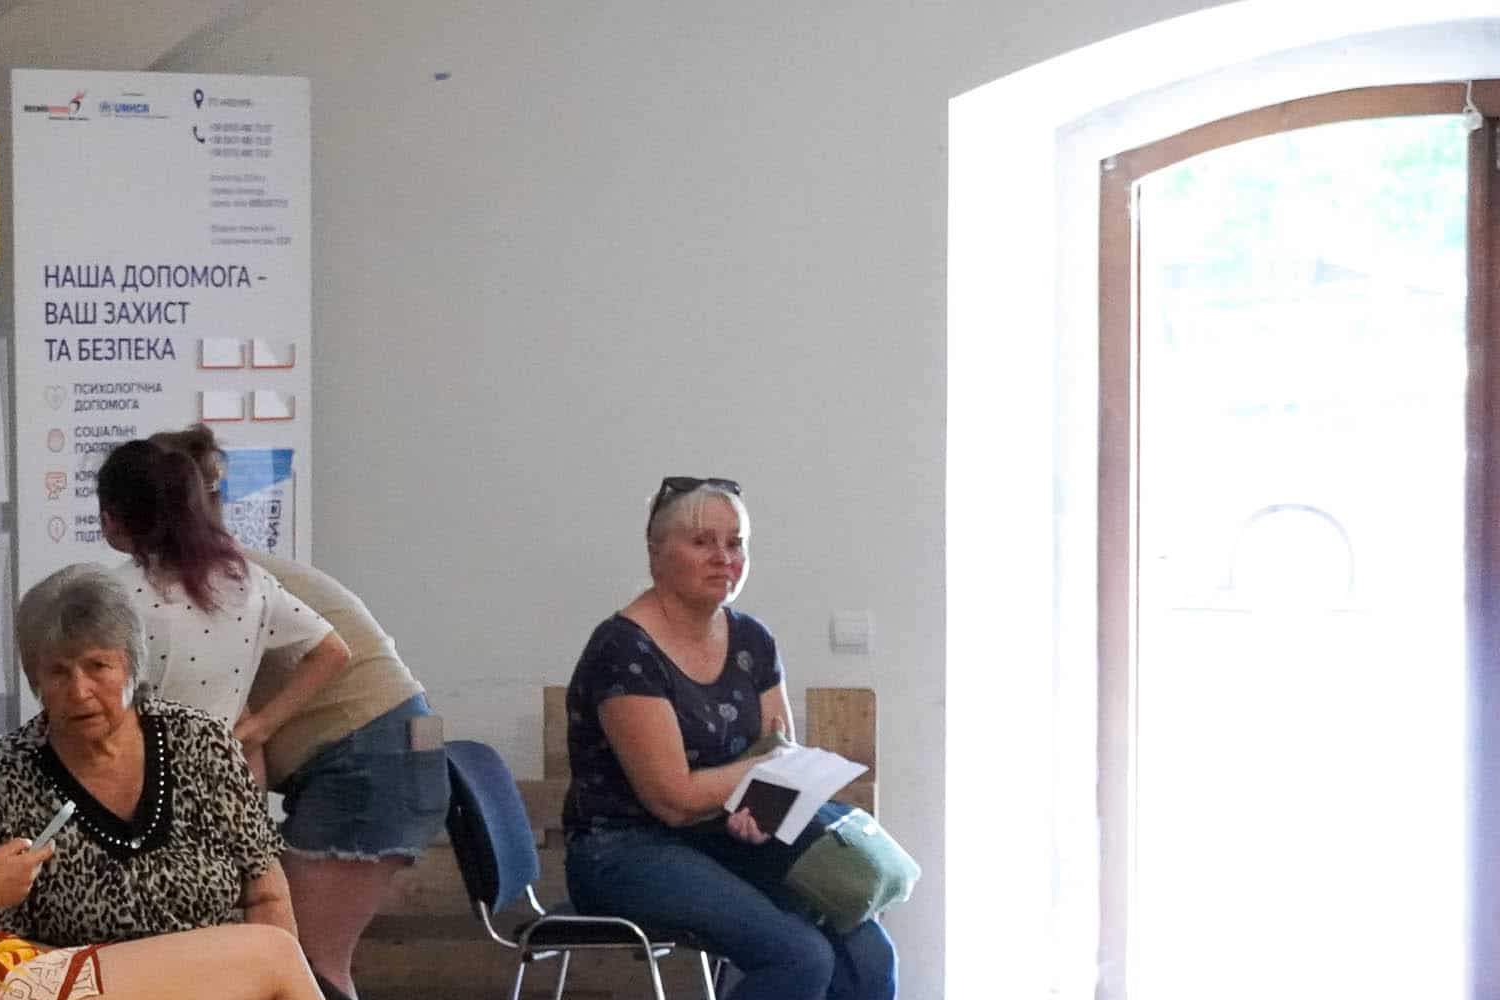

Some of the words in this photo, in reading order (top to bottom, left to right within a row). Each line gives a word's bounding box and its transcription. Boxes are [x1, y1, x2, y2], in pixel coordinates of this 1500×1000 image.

[44, 265, 116, 288] НАША
[121, 264, 251, 293] ДОПОМОГА
[44, 301, 97, 325] ВАШ
[103, 301, 190, 325] ЗАХИСТ
[44, 338, 72, 361] ТА
[77, 337, 177, 361] БЕЗПЕКА
[73, 382, 163, 395] ПСИХОЛОГІЧНА
[73, 398, 140, 412] ДОПОМОГА
